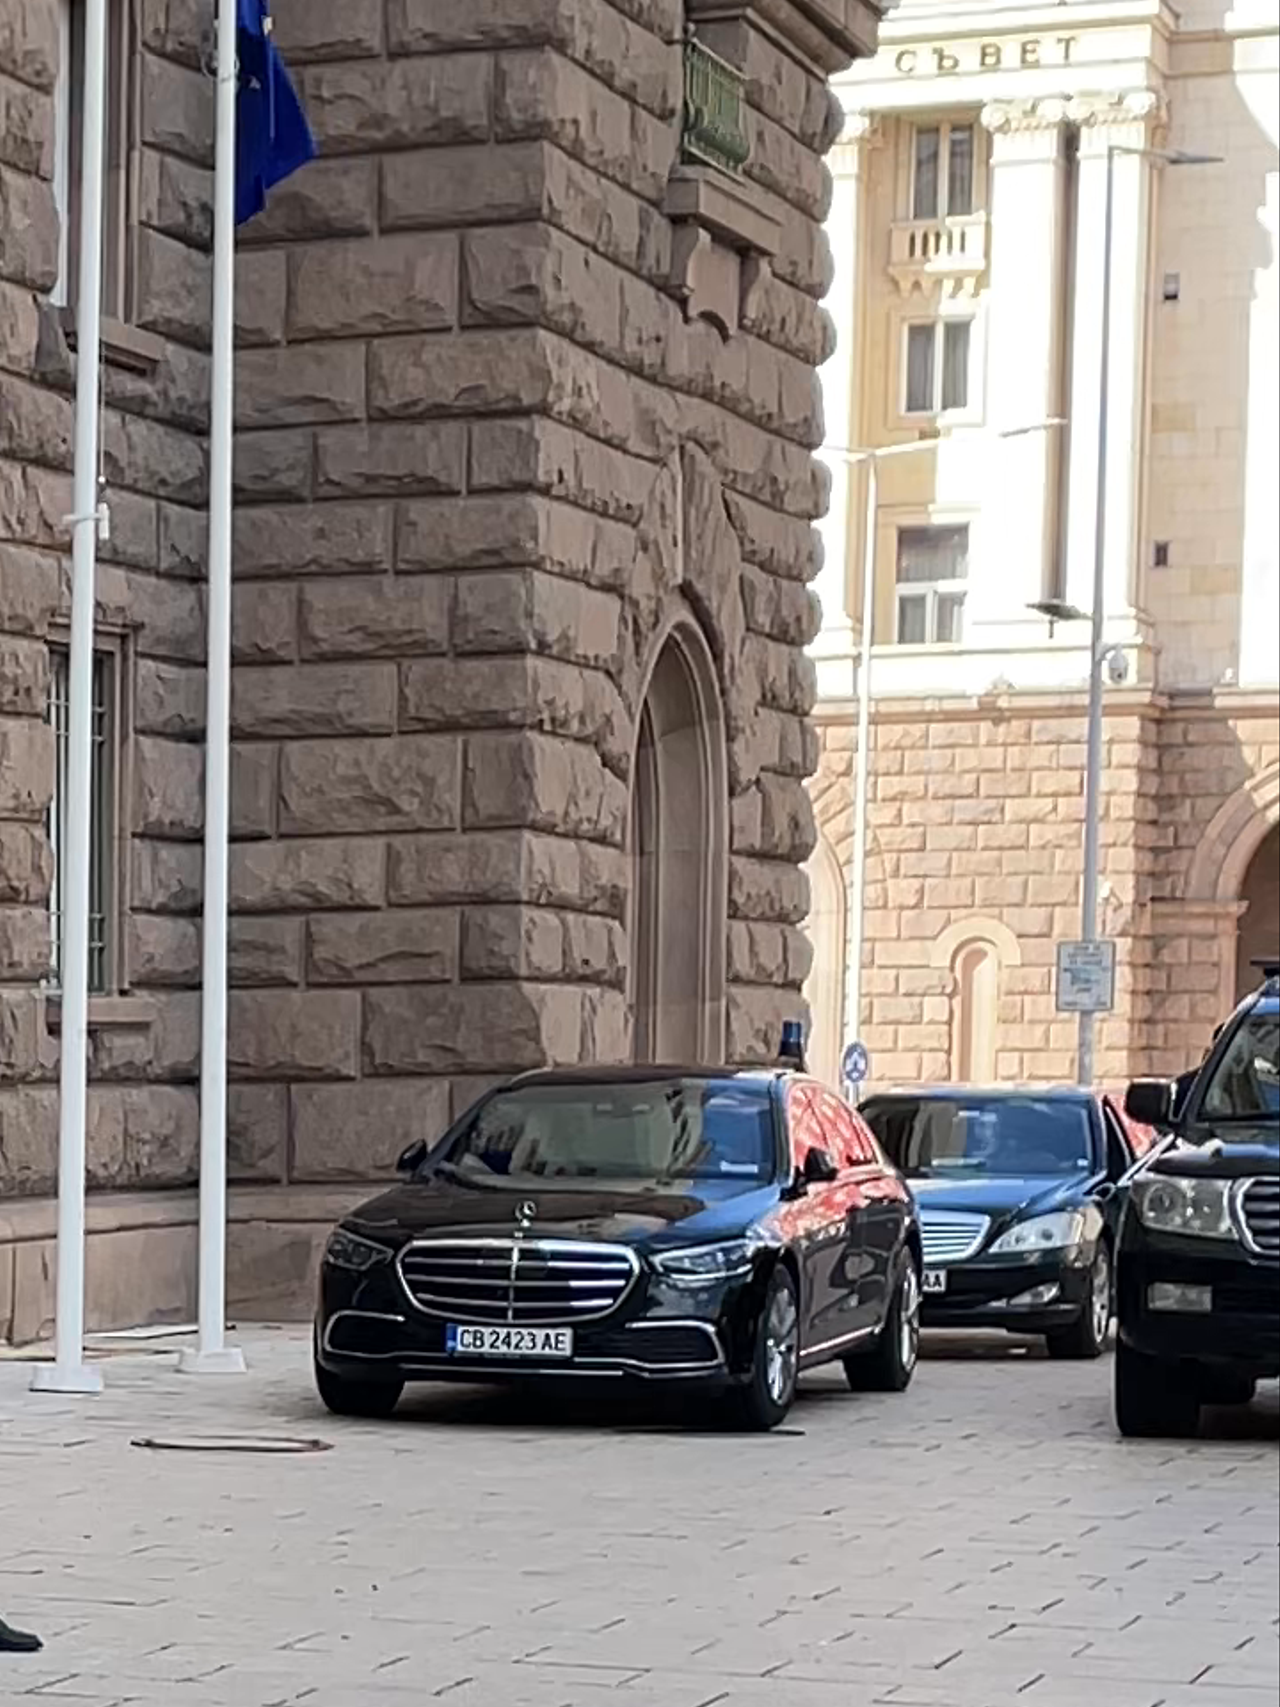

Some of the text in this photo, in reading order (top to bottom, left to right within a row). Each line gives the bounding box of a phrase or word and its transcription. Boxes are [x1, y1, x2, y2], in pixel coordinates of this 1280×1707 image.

[895, 36, 1076, 74] СЪВЕТ
[460, 1329, 566, 1351] CB 2423 AE
